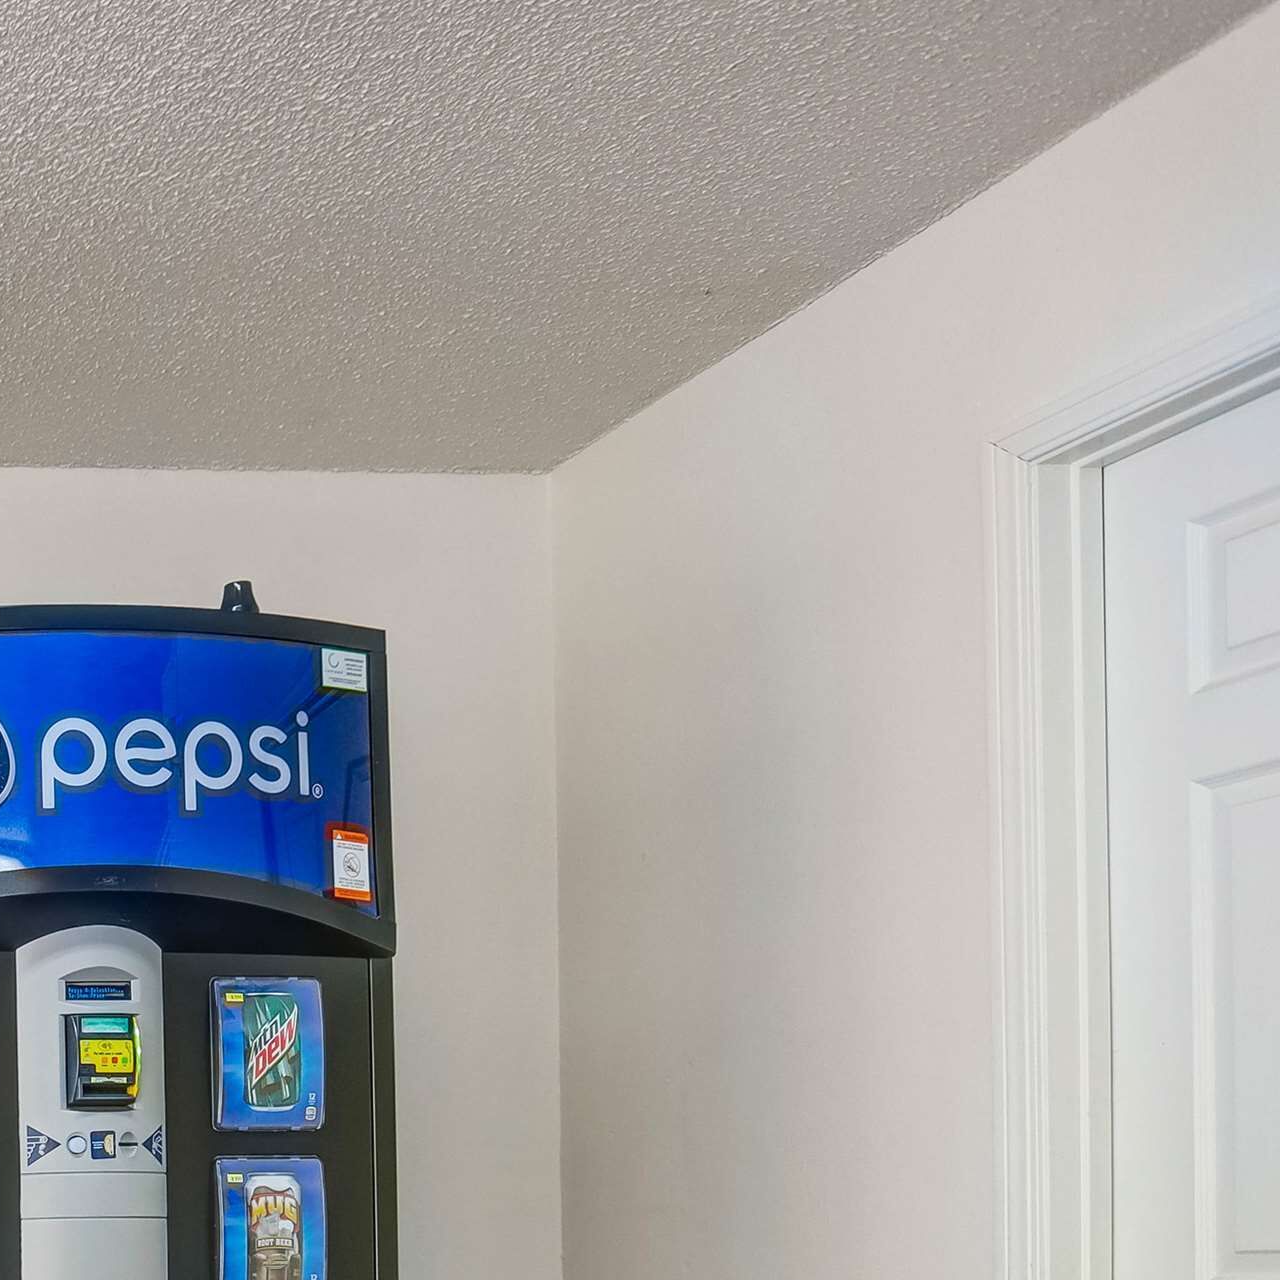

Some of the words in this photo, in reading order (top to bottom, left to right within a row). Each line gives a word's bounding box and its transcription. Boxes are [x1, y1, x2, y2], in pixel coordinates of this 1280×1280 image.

[42, 710, 311, 810] pepsi
[251, 1195, 299, 1226] MUG
[257, 1238, 274, 1247] ROOT
[276, 1238, 293, 1247] BEER
